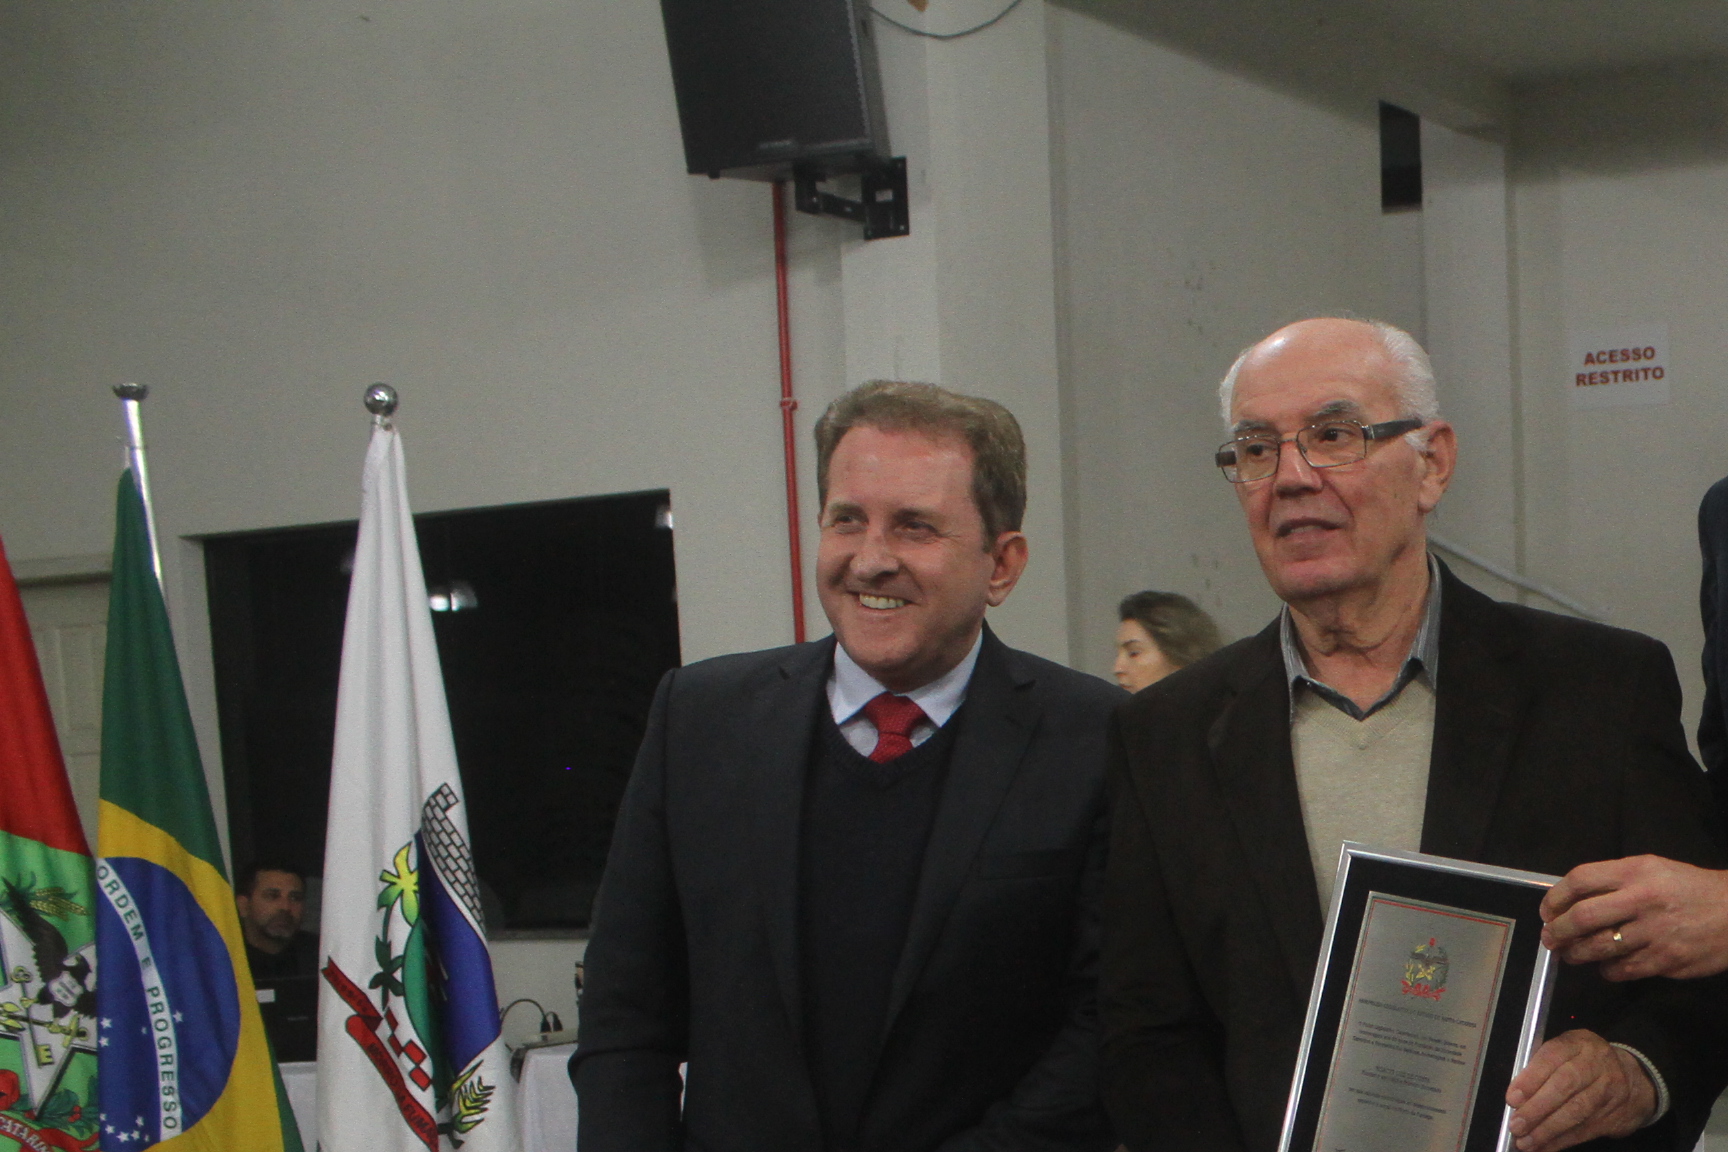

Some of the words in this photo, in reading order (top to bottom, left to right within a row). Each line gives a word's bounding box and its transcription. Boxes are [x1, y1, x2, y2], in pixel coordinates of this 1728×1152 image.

[1584, 346, 1656, 366] ACESSO
[1575, 366, 1665, 387] RESTRITO
[96, 865, 145, 942] ORDEM
[141, 957, 152, 970] E
[147, 985, 178, 1130] PROGRESSO
